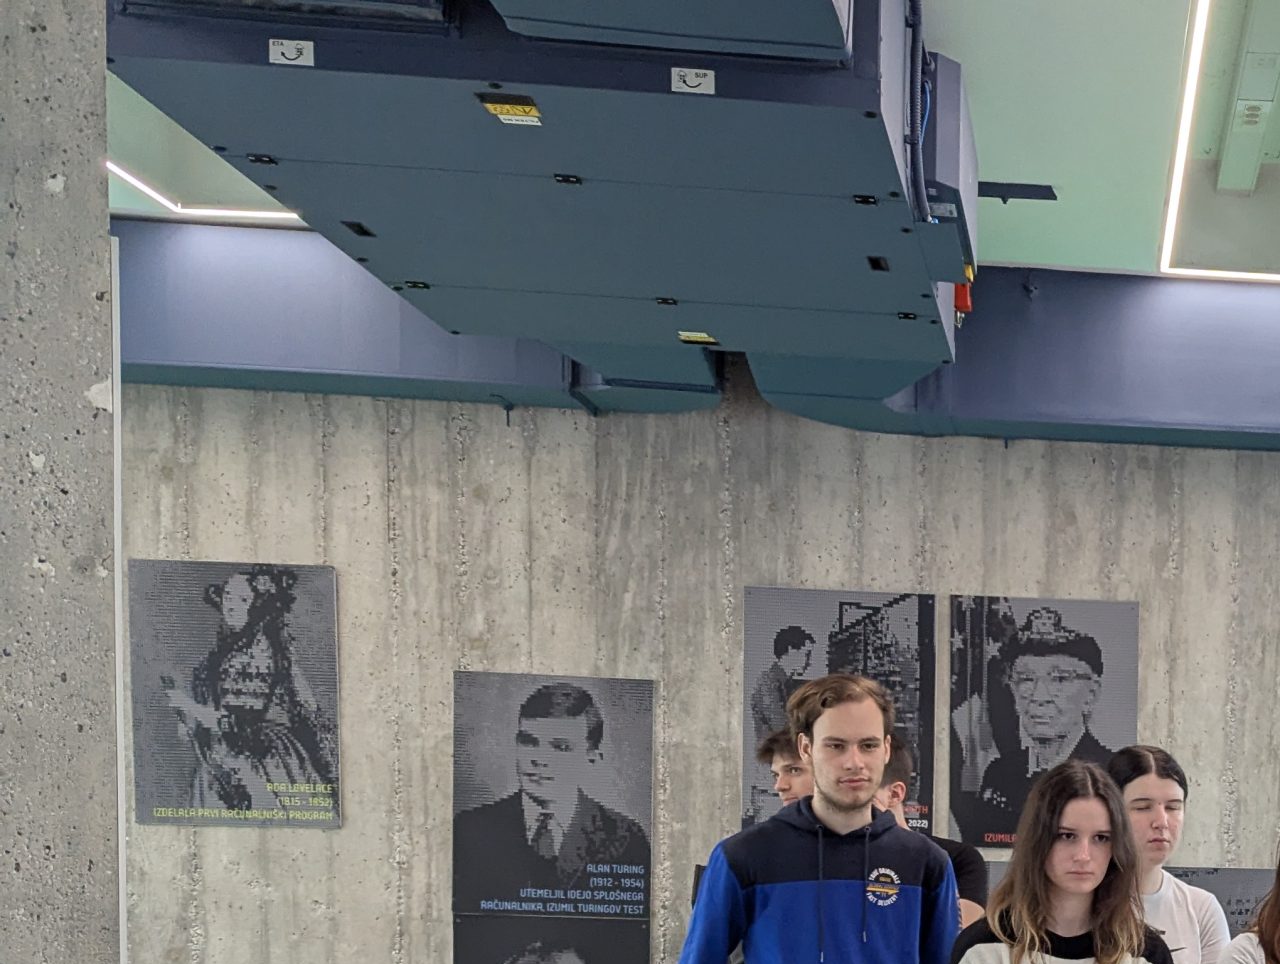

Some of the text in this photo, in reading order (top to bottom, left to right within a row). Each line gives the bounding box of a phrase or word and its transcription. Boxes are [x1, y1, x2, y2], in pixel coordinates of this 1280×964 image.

[266, 783, 333, 793] ADA LOVELACE
[153, 807, 197, 818] IZDELALA
[288, 810, 333, 821] PROGRAM
[586, 863, 645, 875] ALAN TURING
[590, 877, 612, 888] (1912
[620, 878, 645, 889] 1954)
[519, 888, 645, 901] UTEMELJIL IDEJO SPLOŠNEGA
[546, 902, 576, 913] IZUMIL
[577, 904, 621, 914] TURINGOV
[623, 905, 645, 915] TEST
